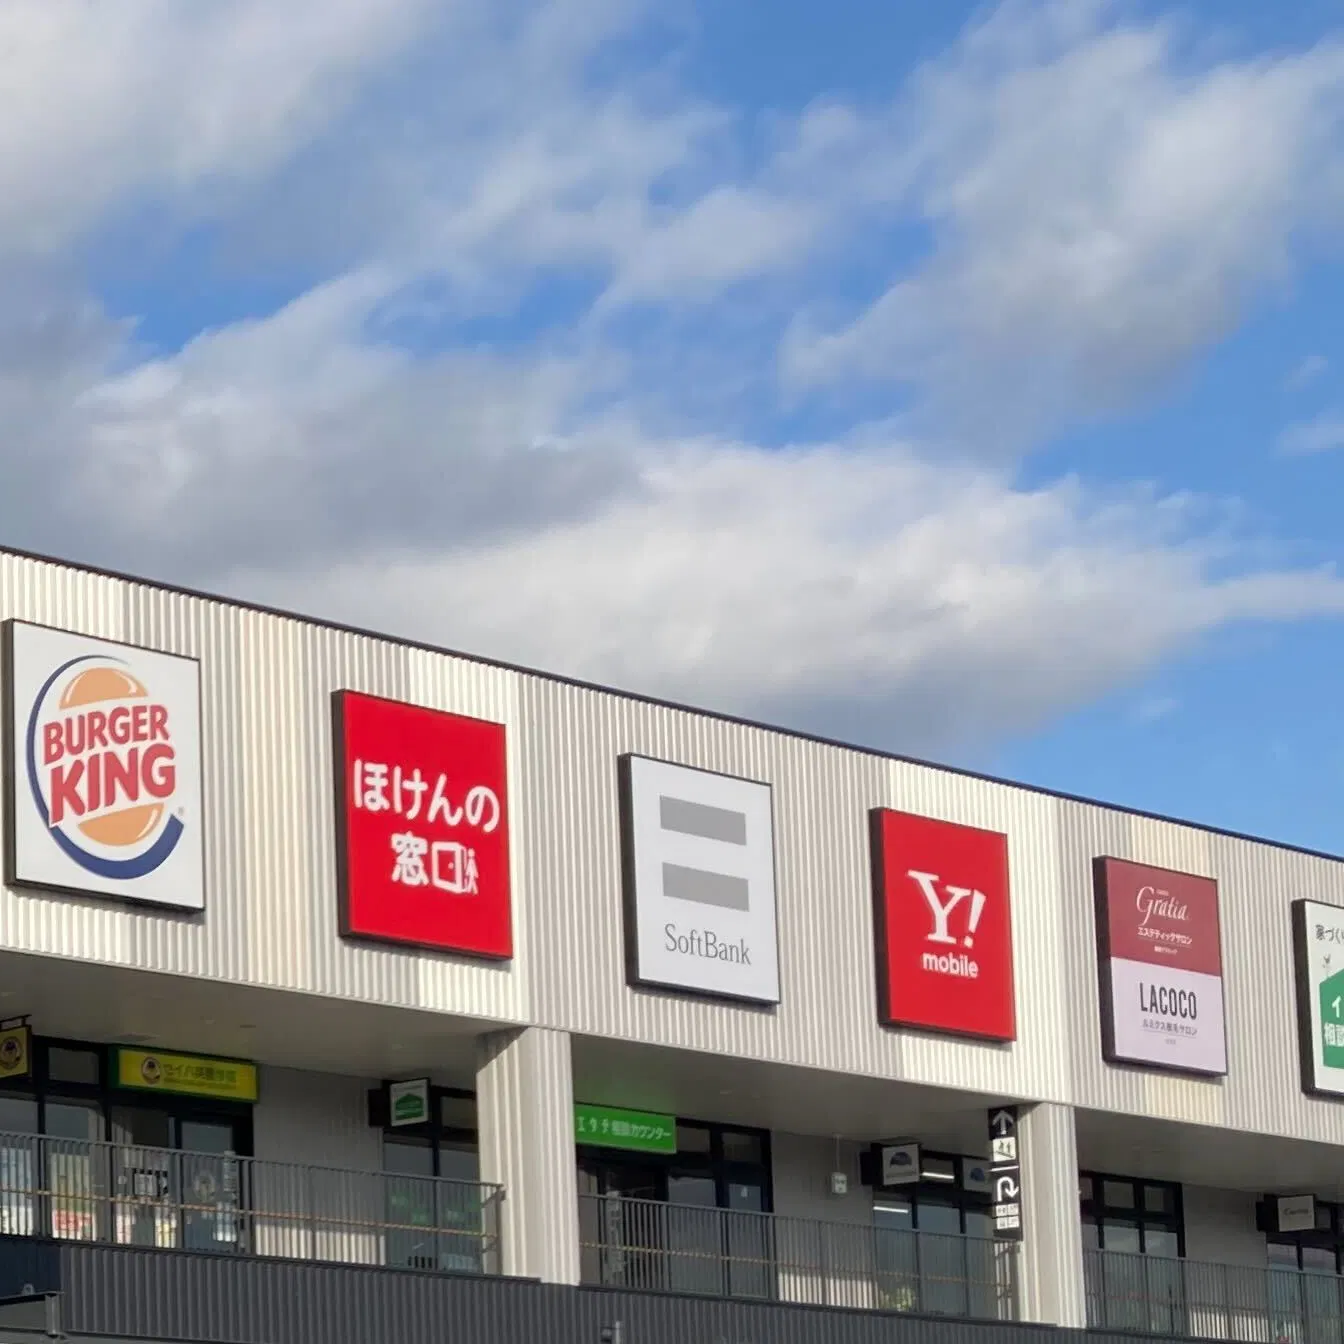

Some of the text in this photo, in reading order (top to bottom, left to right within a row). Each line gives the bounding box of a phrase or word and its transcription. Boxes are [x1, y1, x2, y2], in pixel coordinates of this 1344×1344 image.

[42, 703, 170, 765] BURGER
[49, 742, 177, 825] KING
[353, 759, 501, 833] ほけんの
[391, 831, 475, 896] 窓口
[1136, 886, 1189, 926] Gratia
[664, 923, 752, 966] SoftBank
[920, 950, 979, 979] mobile
[1139, 981, 1198, 1021] LACOCO
